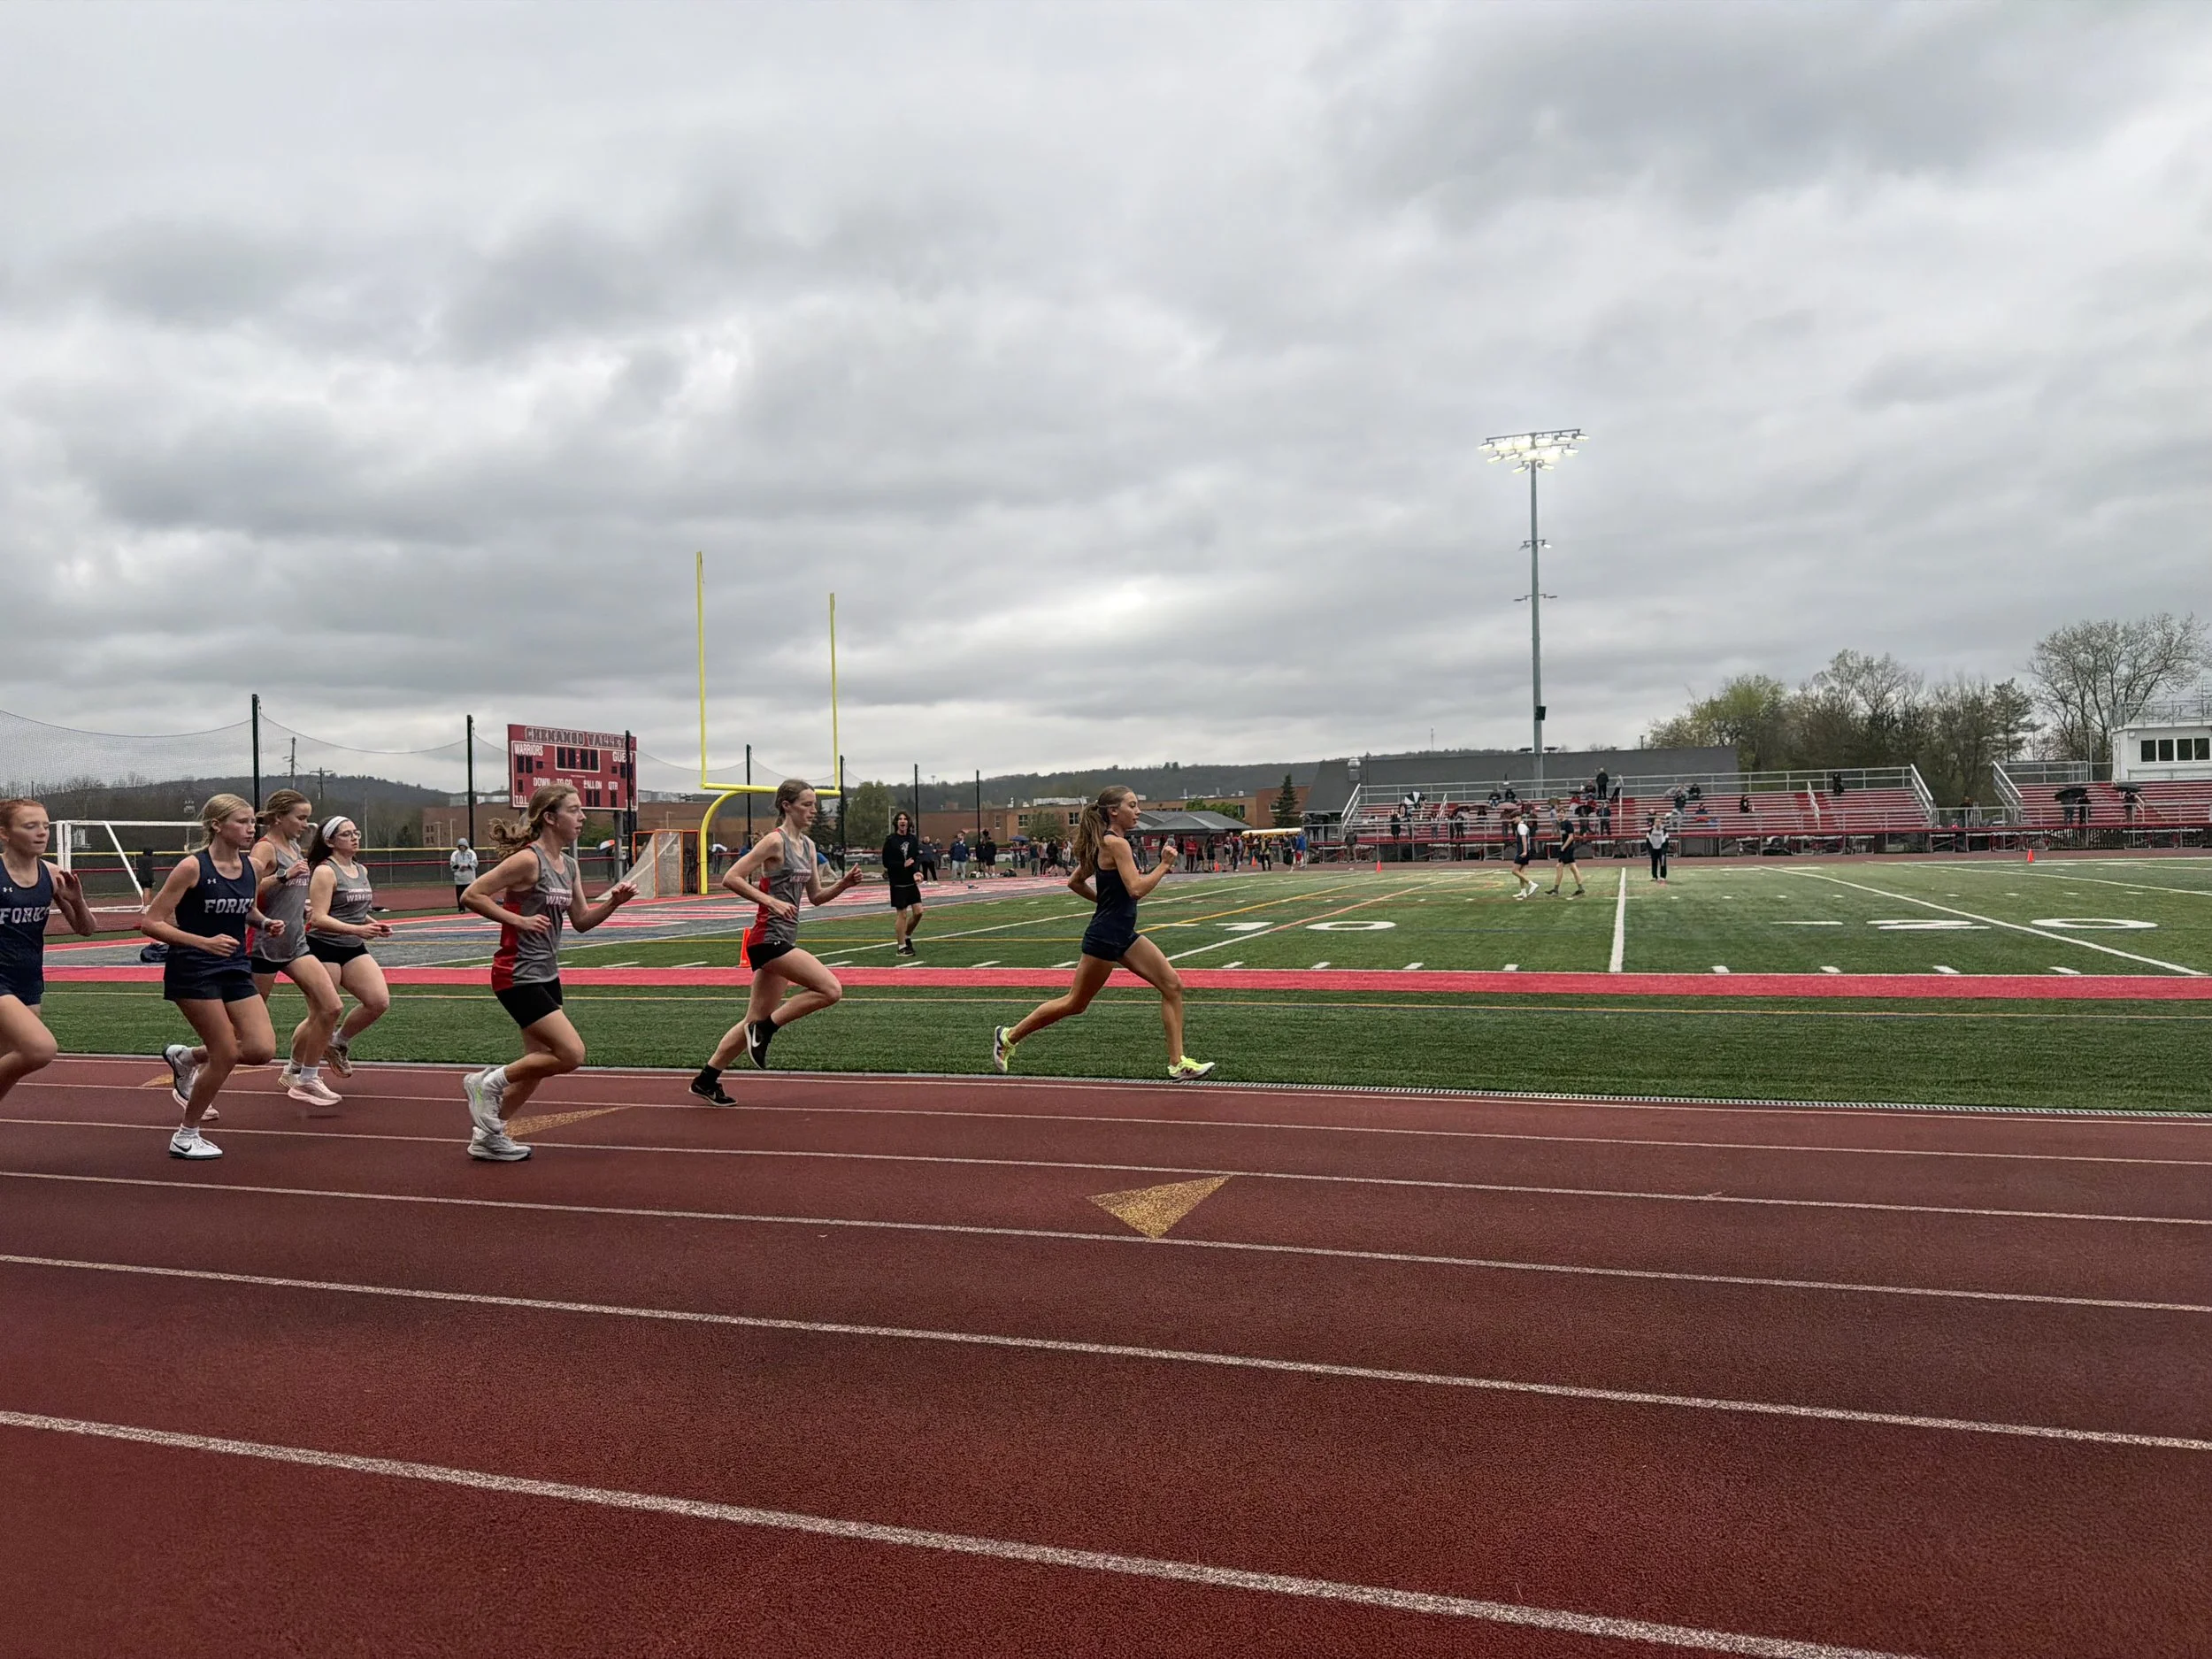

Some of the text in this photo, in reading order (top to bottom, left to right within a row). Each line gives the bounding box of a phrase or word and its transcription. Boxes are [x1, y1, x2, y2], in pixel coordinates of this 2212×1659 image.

[526, 726, 626, 749] CHENANGO VALLEY
[514, 742, 543, 757] WARRIORS
[612, 751, 633, 764] GUET
[533, 777, 550, 787] DOWN
